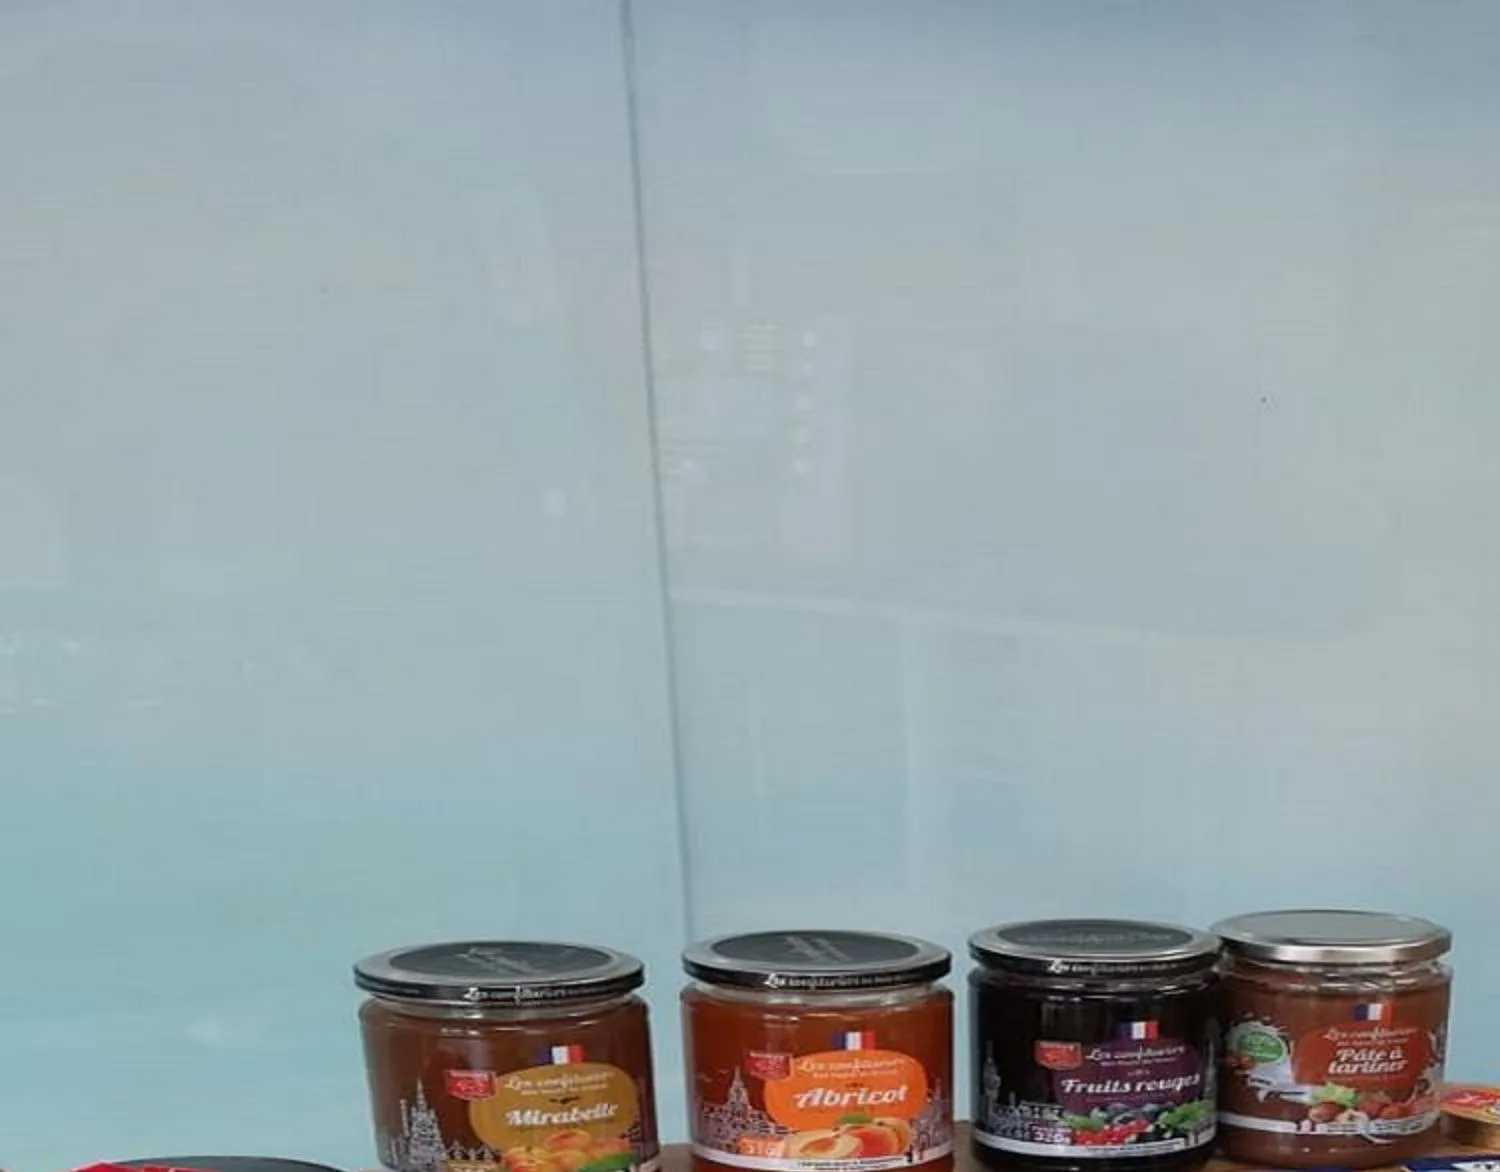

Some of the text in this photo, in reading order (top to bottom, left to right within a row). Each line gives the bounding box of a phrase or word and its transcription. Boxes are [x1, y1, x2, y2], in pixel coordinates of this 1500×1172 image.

[1060, 1073, 1202, 1096] Fruits rouges
[792, 1085, 910, 1109] Abricot
[505, 1102, 620, 1127] Mirabelle
